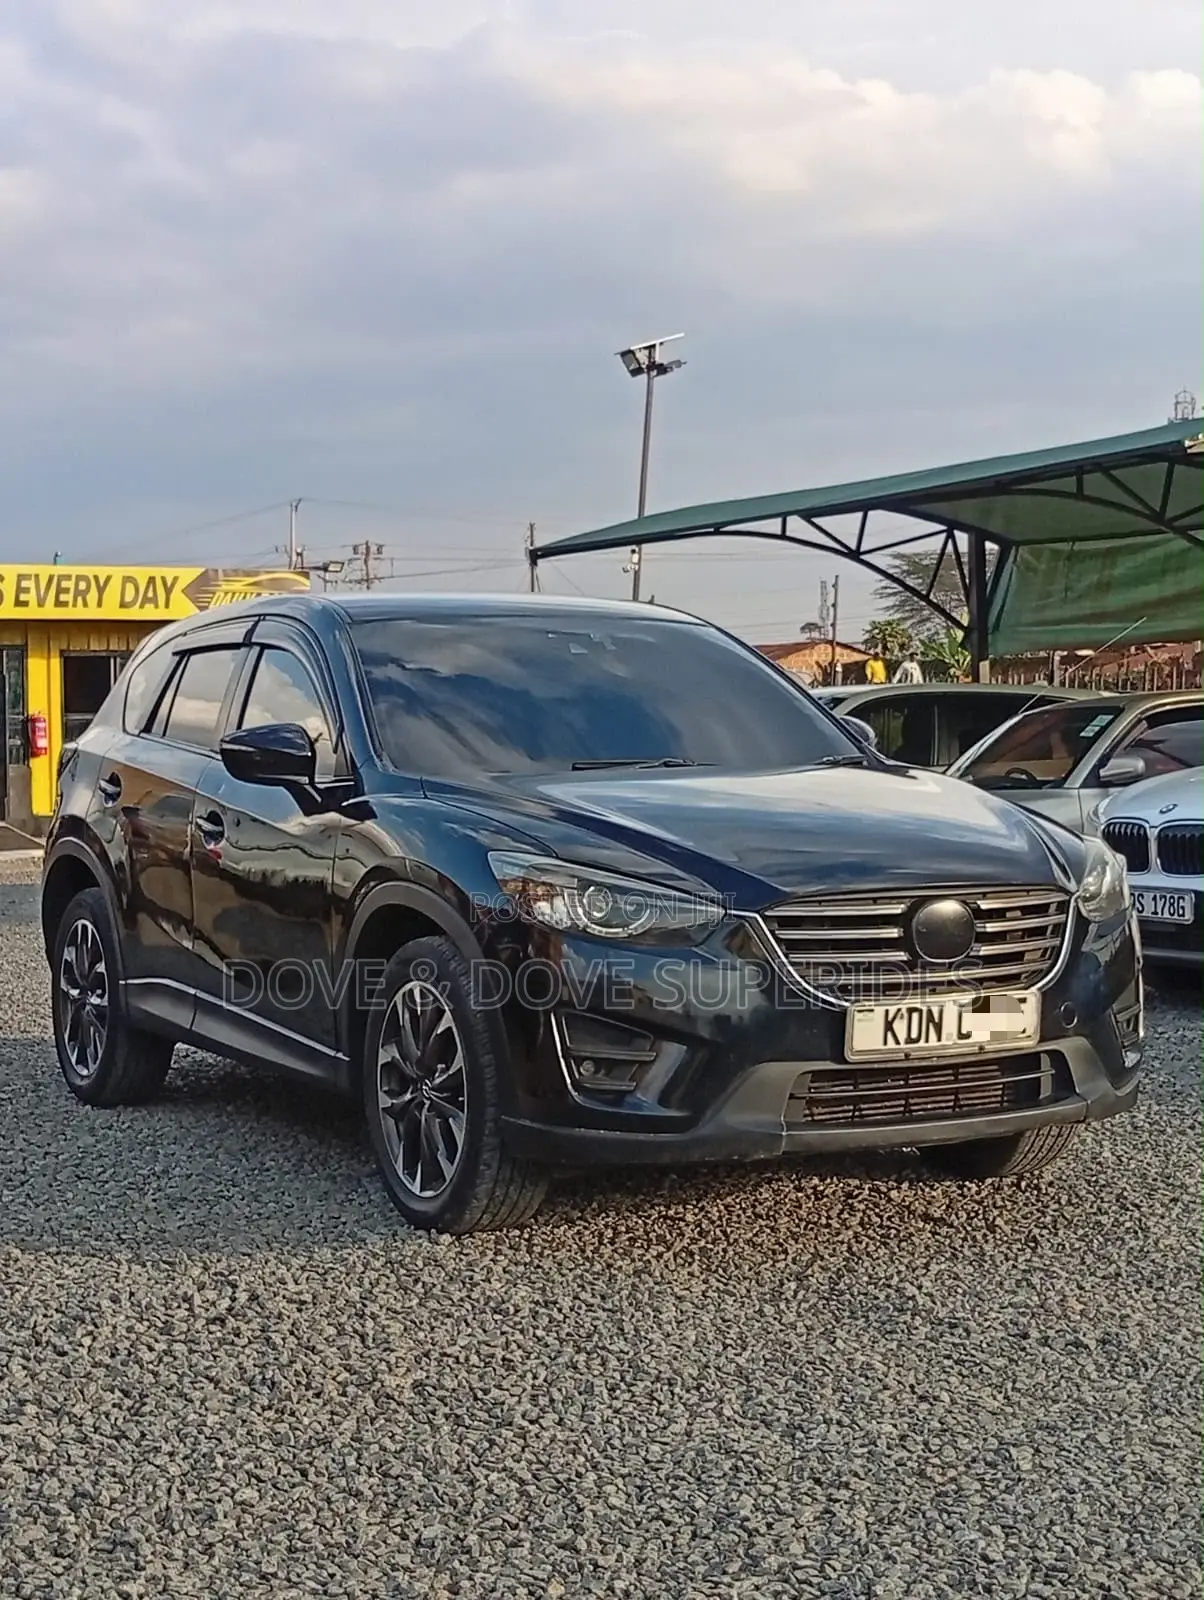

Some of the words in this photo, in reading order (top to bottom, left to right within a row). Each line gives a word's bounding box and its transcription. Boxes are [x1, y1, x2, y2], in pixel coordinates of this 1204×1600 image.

[13, 573, 113, 609] EVERY
[119, 575, 180, 610] DAY
[1151, 893, 1186, 918] 178G
[882, 1006, 945, 1047] KDN
